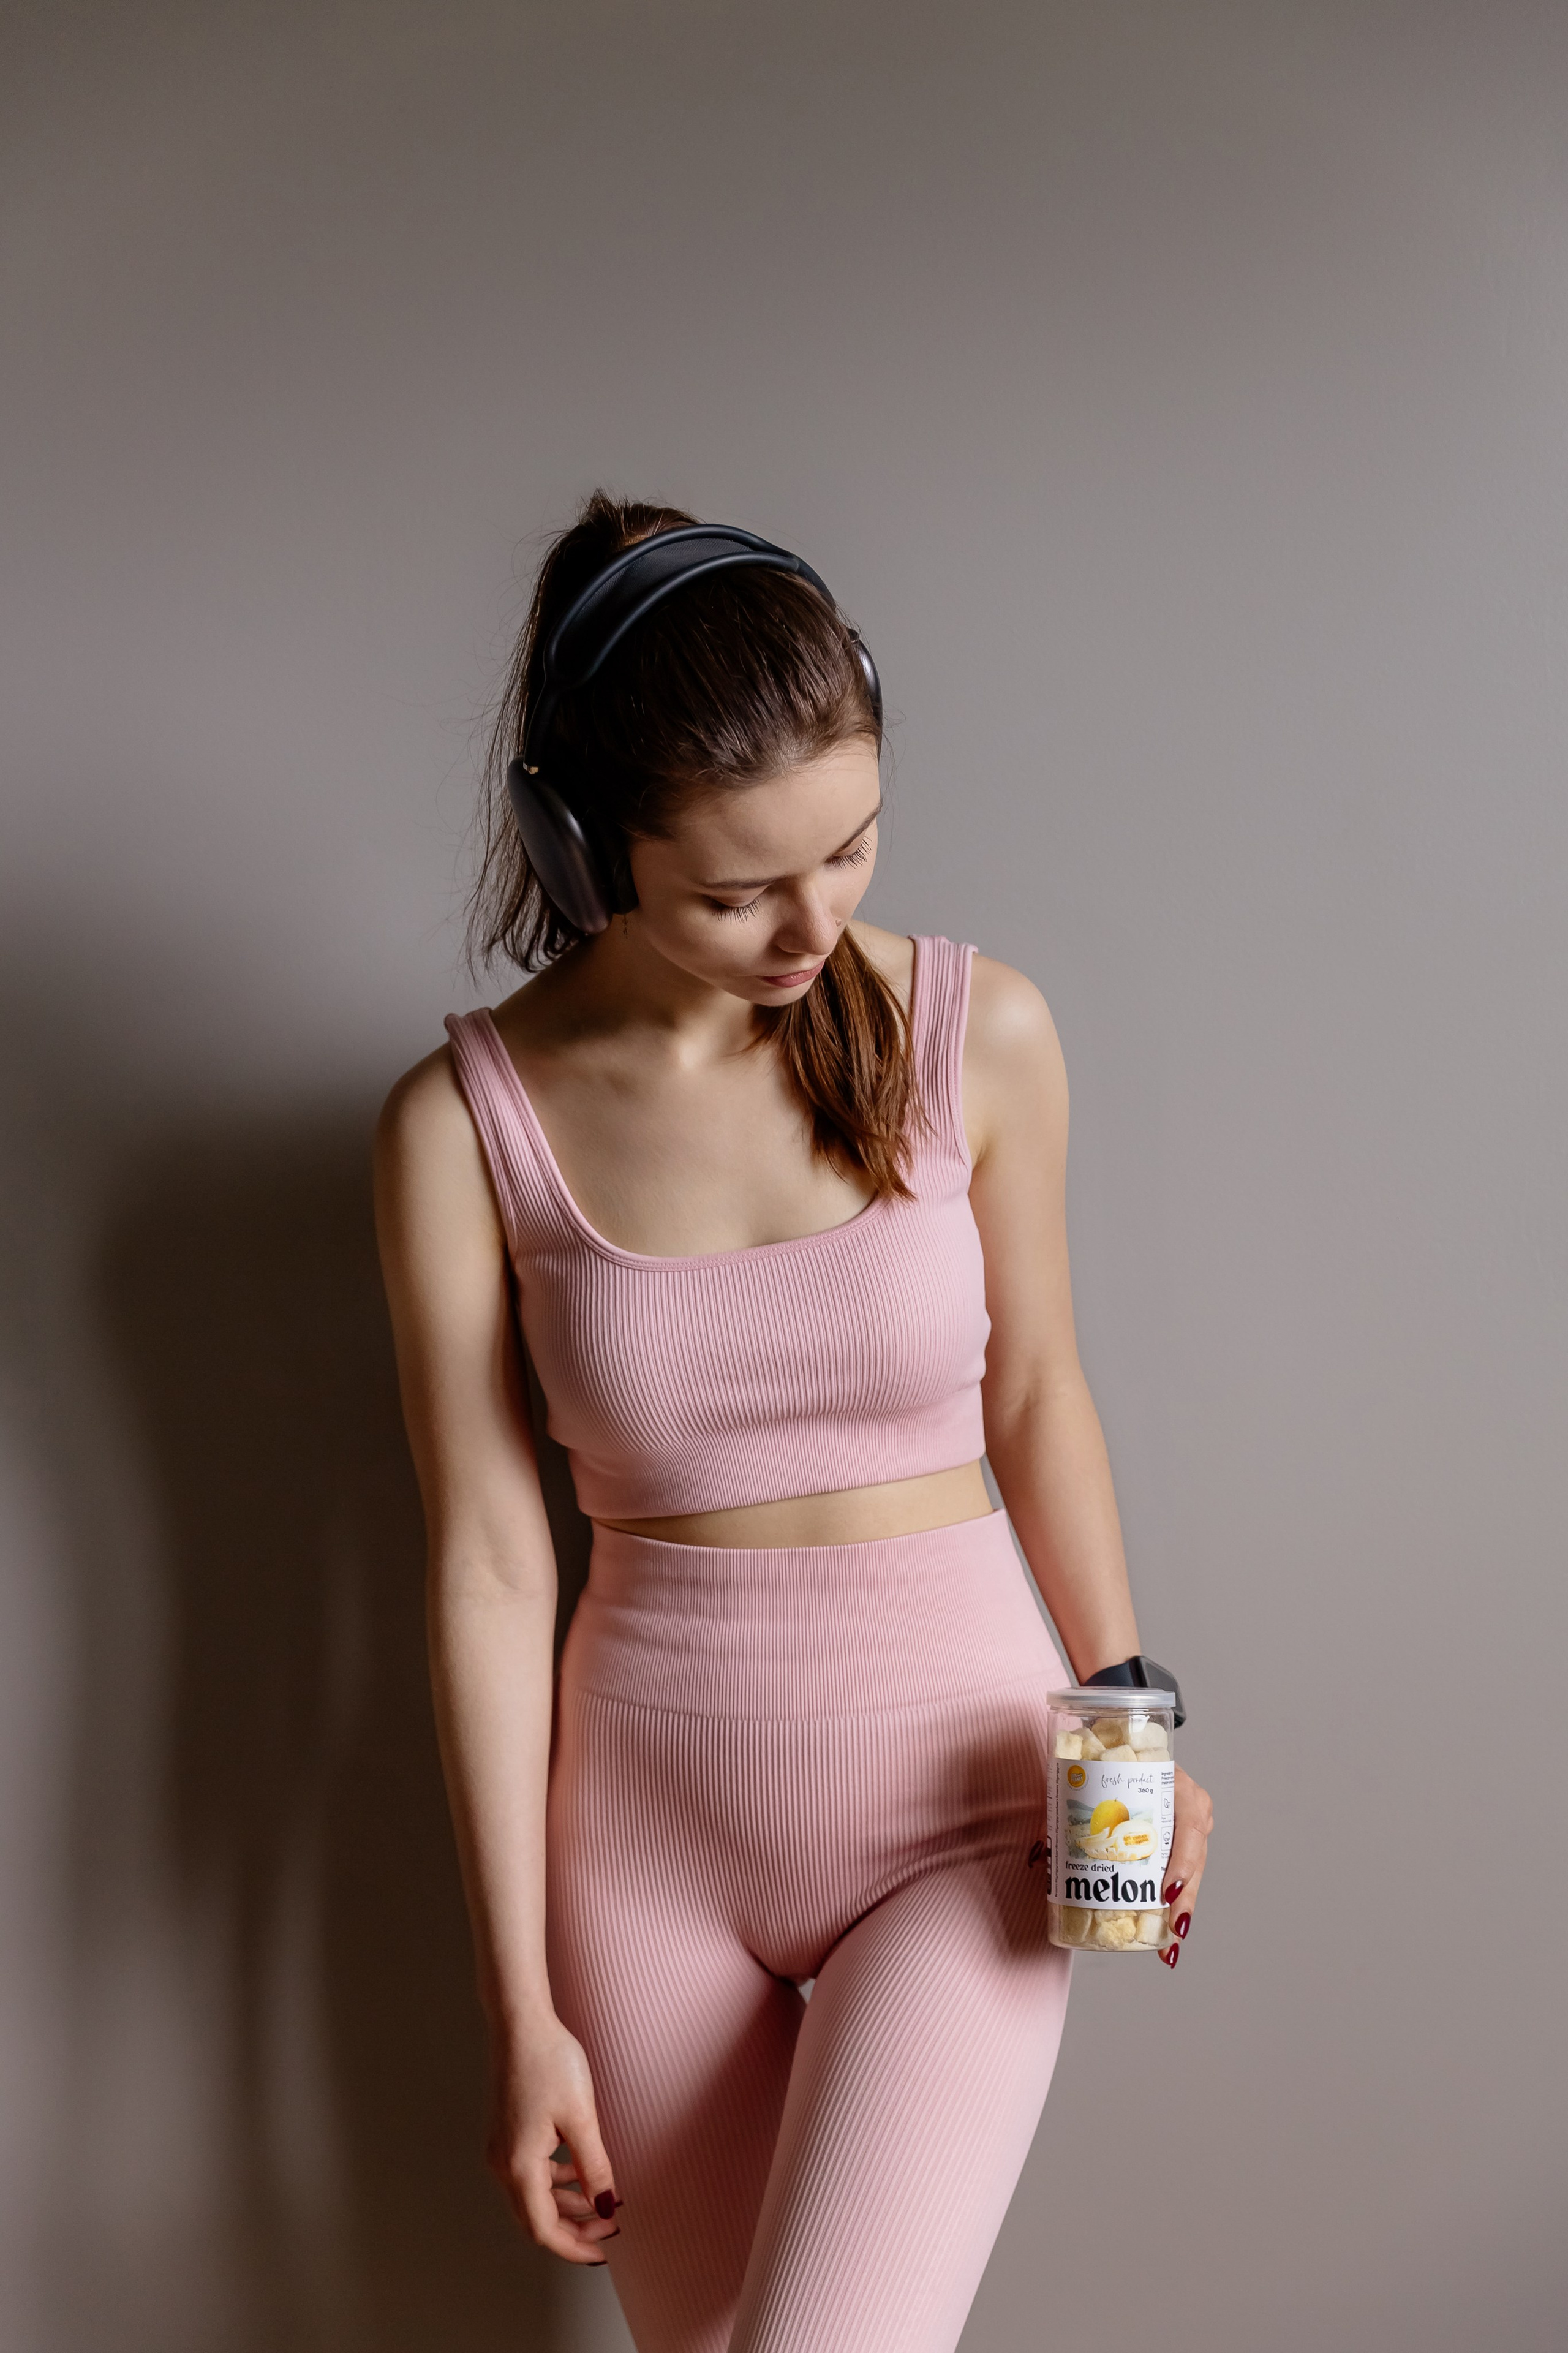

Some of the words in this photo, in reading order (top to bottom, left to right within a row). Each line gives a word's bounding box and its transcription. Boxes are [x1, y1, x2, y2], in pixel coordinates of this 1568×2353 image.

[1101, 1773, 1124, 1788] fresh
[1128, 1773, 1153, 1789] product
[1065, 1861, 1088, 1871] freeze
[1091, 1864, 1115, 1872] dried
[1065, 1871, 1156, 1903] melon
